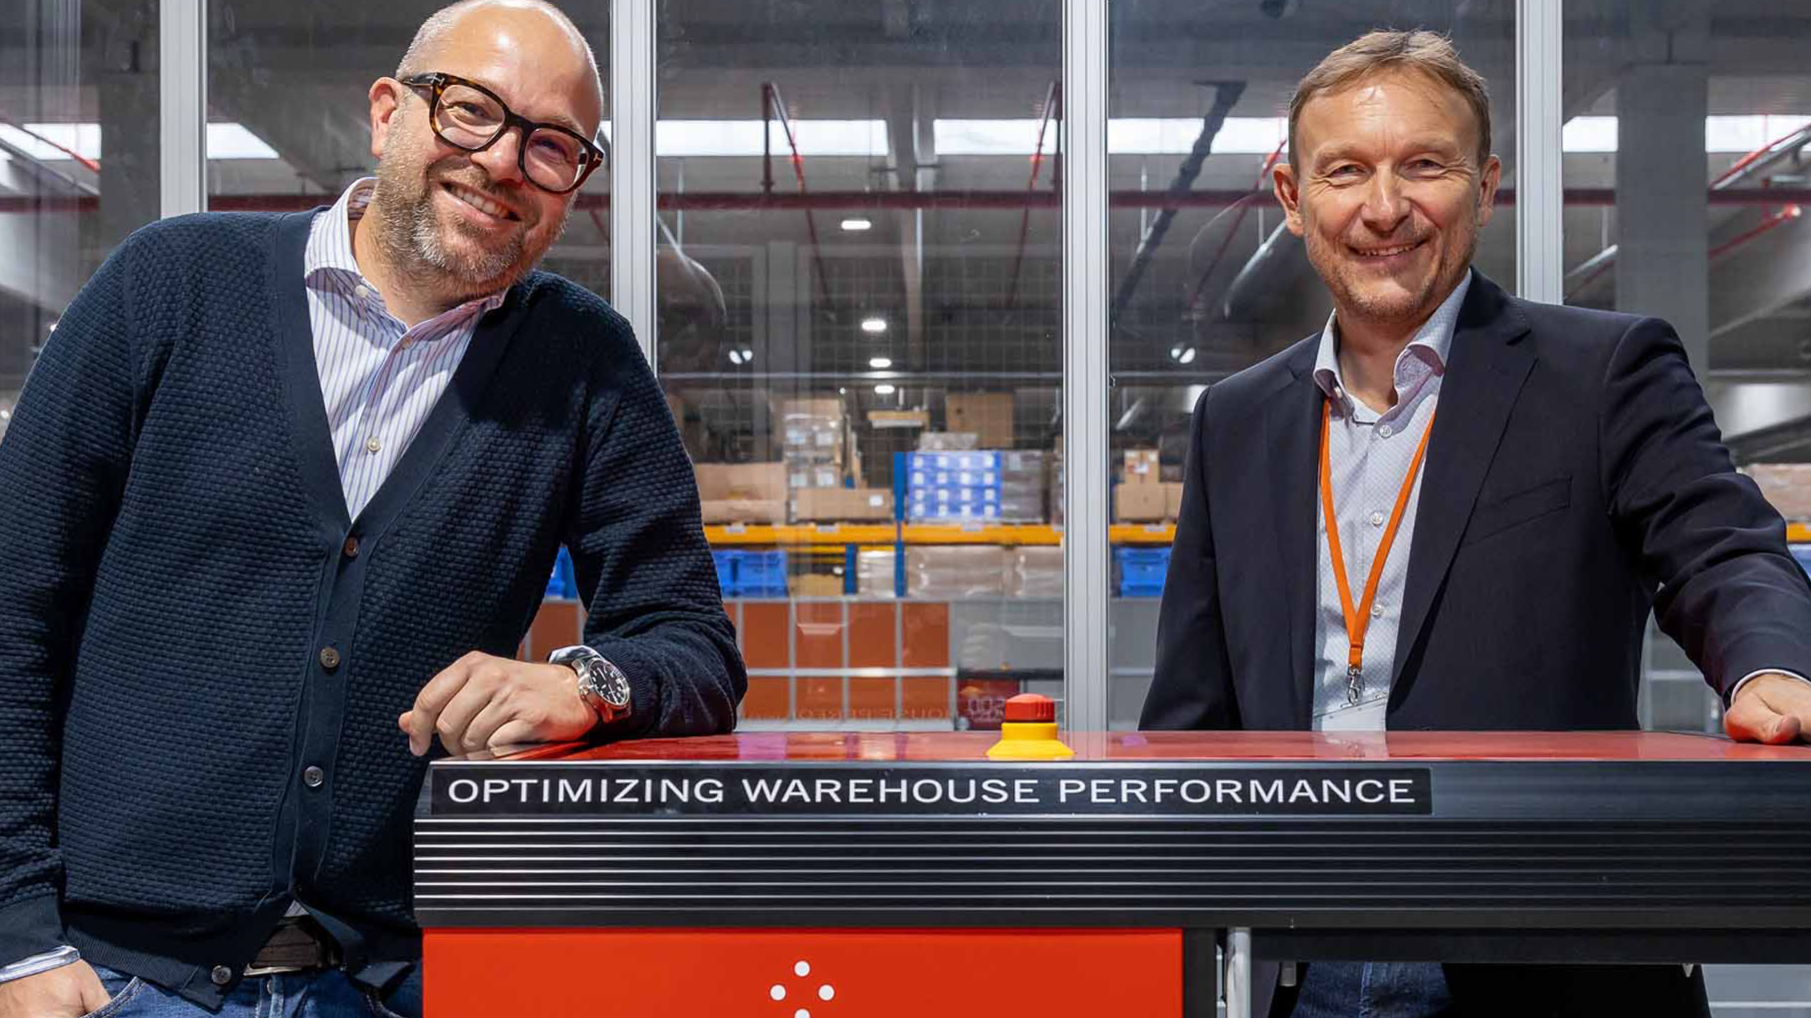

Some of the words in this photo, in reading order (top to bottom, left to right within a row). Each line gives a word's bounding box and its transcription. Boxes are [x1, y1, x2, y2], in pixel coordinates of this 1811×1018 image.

[448, 778, 724, 803] OPTIMIZING
[741, 778, 1040, 803] WAREHOUSE
[1059, 778, 1415, 803] PERFORMANCE
